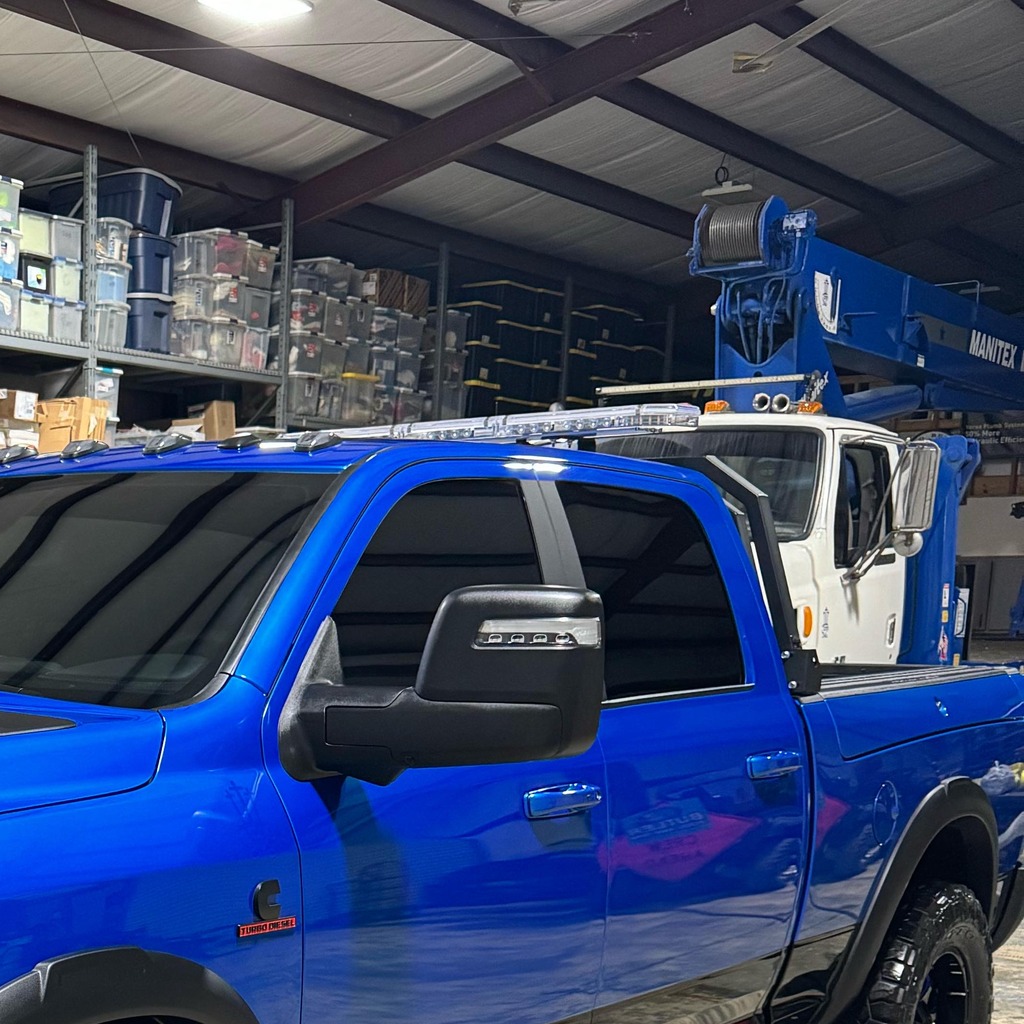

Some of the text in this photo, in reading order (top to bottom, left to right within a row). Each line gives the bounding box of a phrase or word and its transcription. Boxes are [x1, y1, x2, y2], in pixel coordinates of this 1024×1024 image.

[969, 329, 1017, 369] MANITEX
[241, 917, 296, 936] TURBO DIESEL
